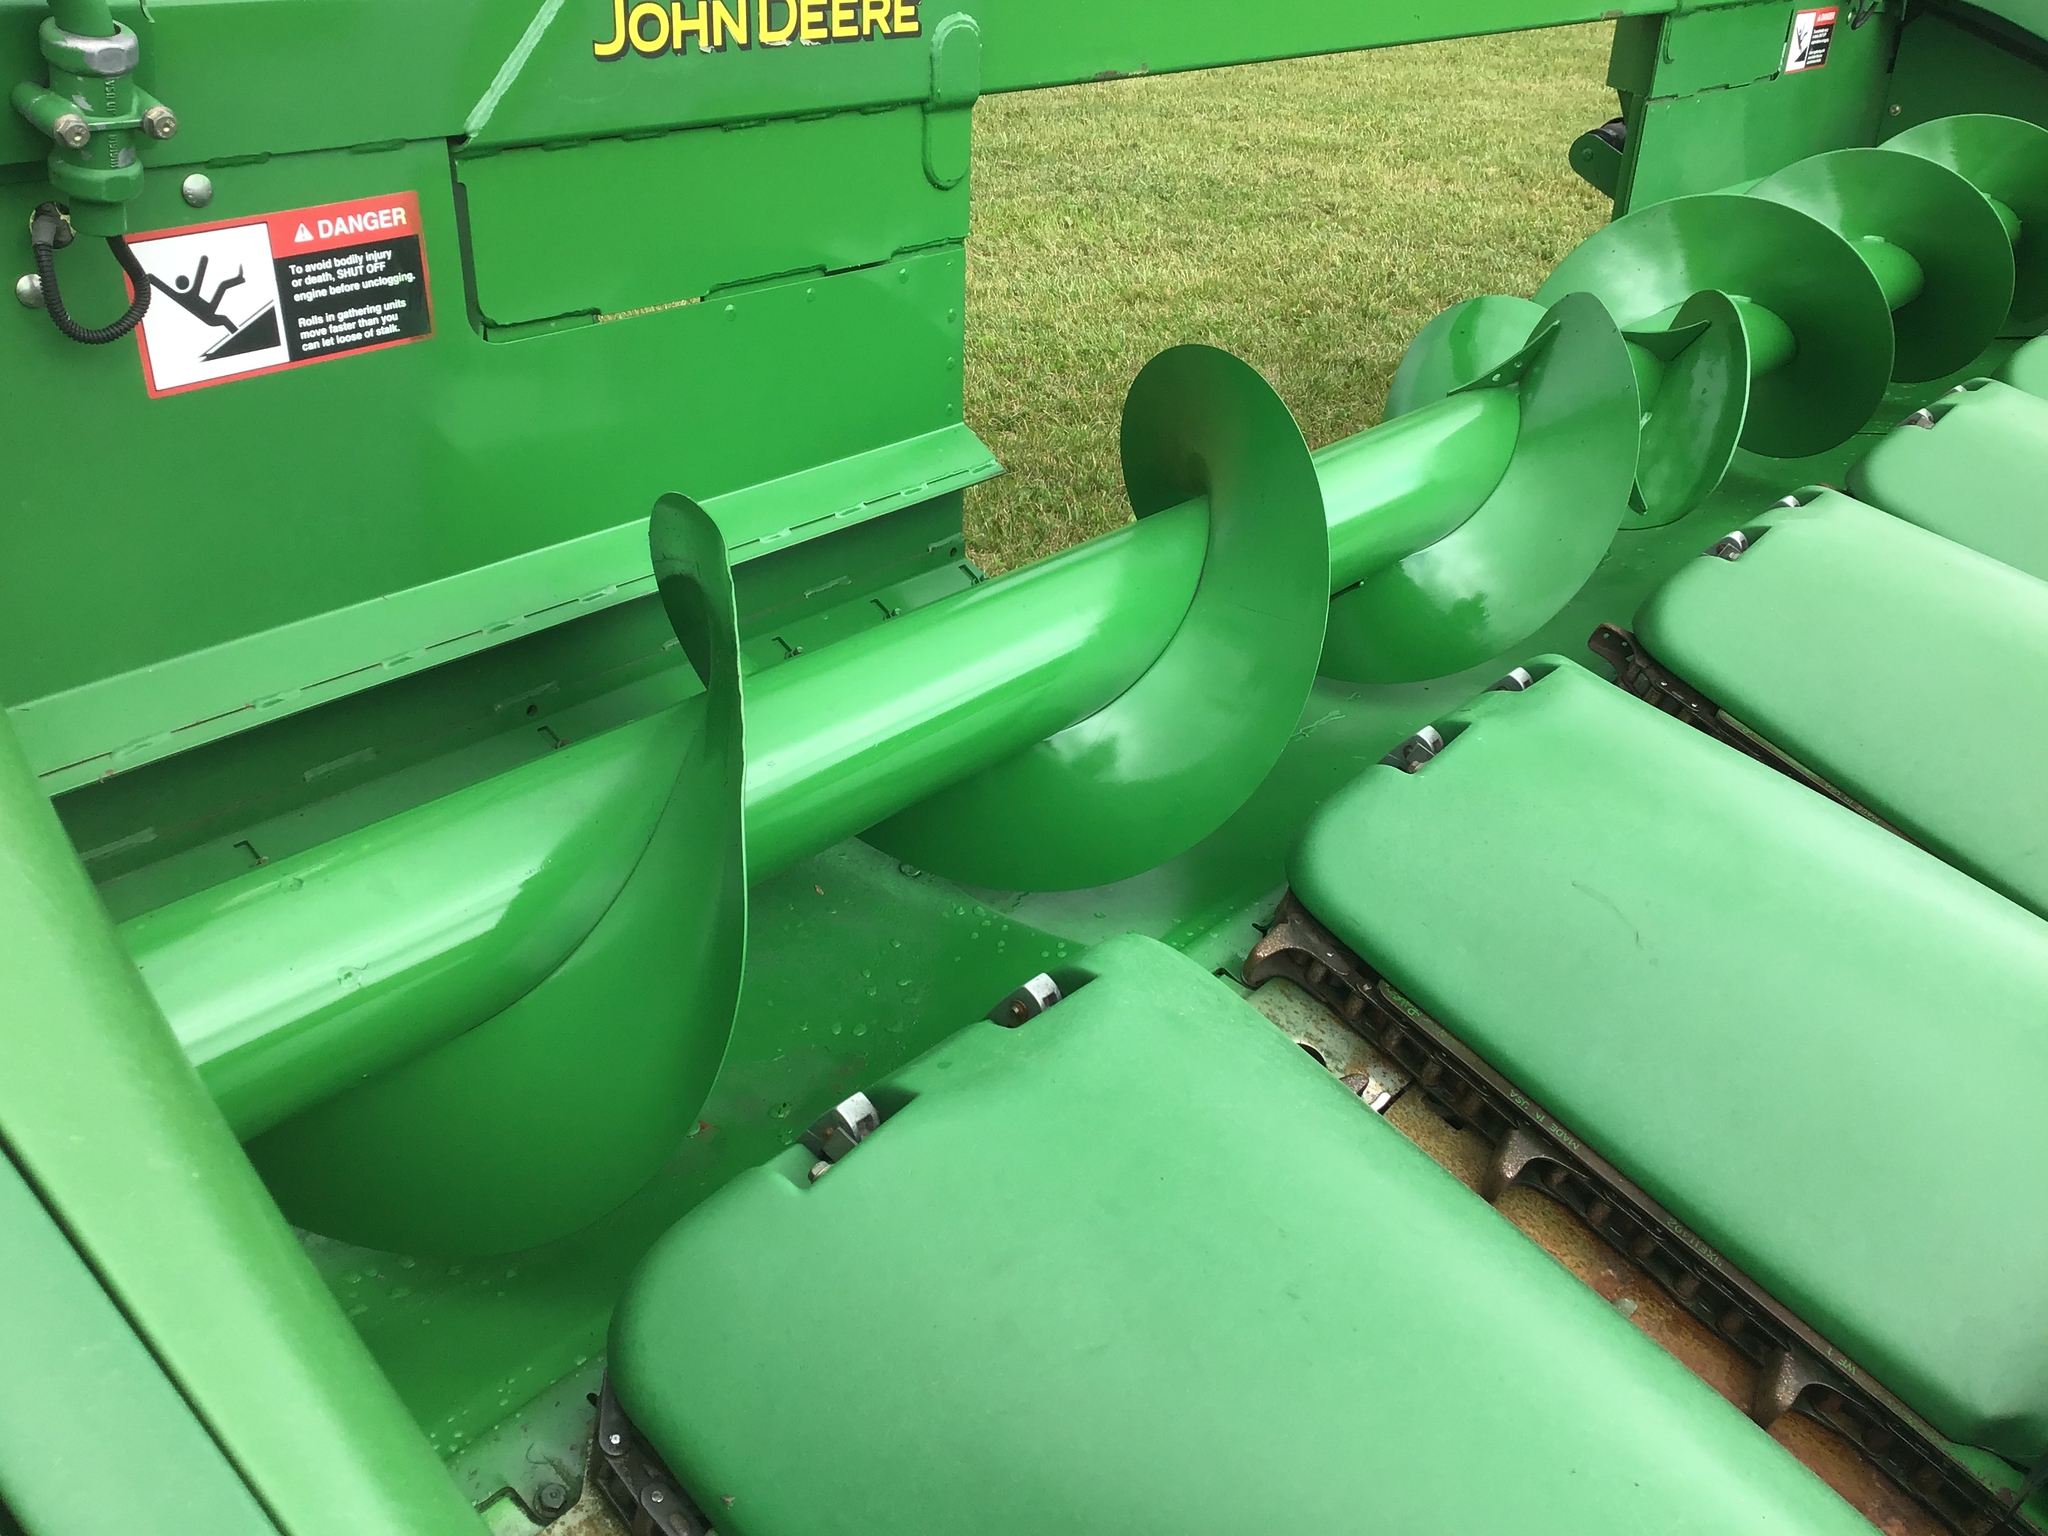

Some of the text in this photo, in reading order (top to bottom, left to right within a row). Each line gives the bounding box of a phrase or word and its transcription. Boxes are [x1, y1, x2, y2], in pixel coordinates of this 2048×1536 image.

[593, 0, 921, 58] JOHN DEERE
[317, 207, 407, 238] DANGER
[289, 250, 392, 275] To avoid bodily injury
[292, 262, 385, 287] or death, SHUT OFF
[294, 271, 416, 301] engine before unclogging.
[298, 299, 406, 328] Rolls in gathering units
[300, 312, 398, 339] move faster than you
[302, 323, 400, 351] can let loose of stalk.
[1549, 1122, 1580, 1150] MADE
